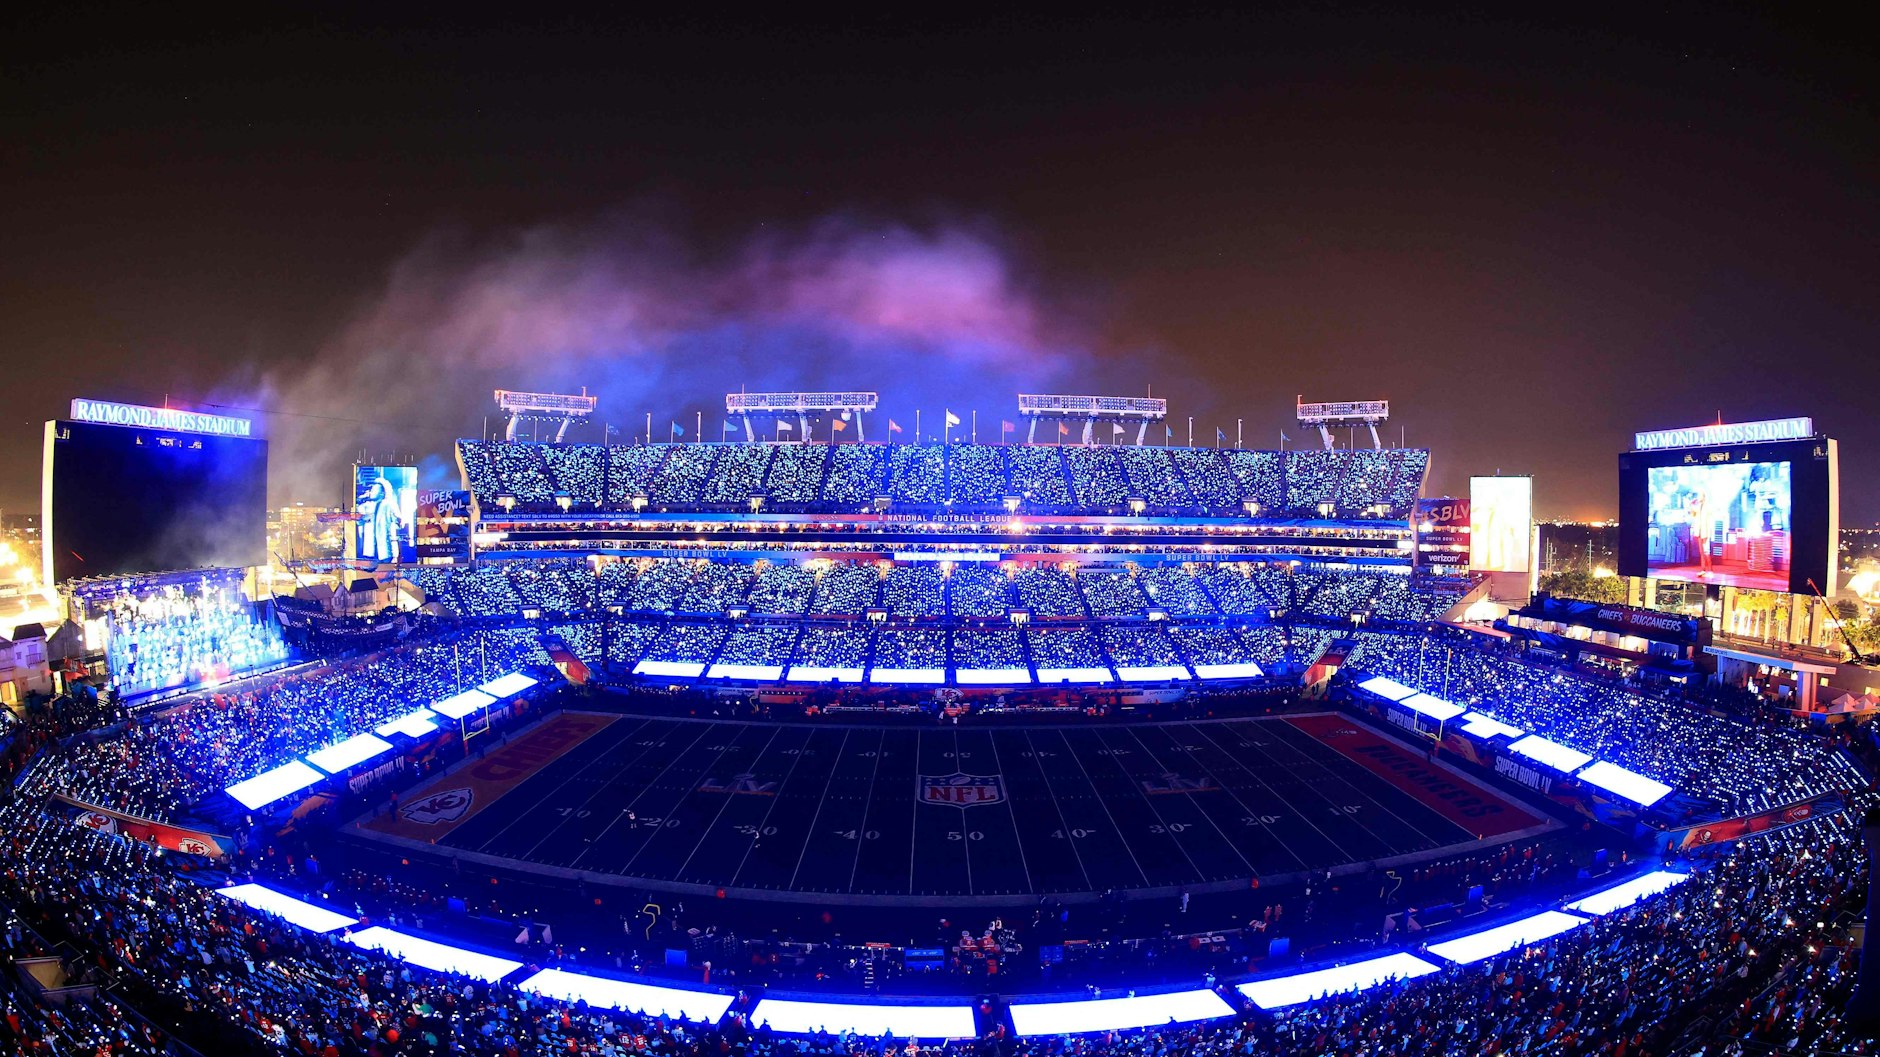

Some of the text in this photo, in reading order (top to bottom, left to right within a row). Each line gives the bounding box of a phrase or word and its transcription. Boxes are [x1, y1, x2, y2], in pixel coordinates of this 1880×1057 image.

[77, 401, 250, 436] RAYMOND JAMES STADIUM
[1636, 419, 1807, 450] RAYMOND JAMES STADIUM
[420, 490, 453, 506] SUPER
[438, 499, 466, 514] BOWL
[887, 514, 927, 522] NATIONAL
[932, 514, 975, 522] FOOTBALL
[1428, 554, 1458, 563] verizon
[1597, 608, 1623, 621] CHIEFS
[1630, 614, 1682, 632] BUCCANEERS
[1387, 707, 1403, 727] SUPER
[1495, 756, 1552, 795] SUPER BOWL LV
[928, 786, 996, 803] NFL
[842, 828, 881, 840] 40
[946, 830, 985, 841] 50
[1050, 828, 1088, 840] 40
